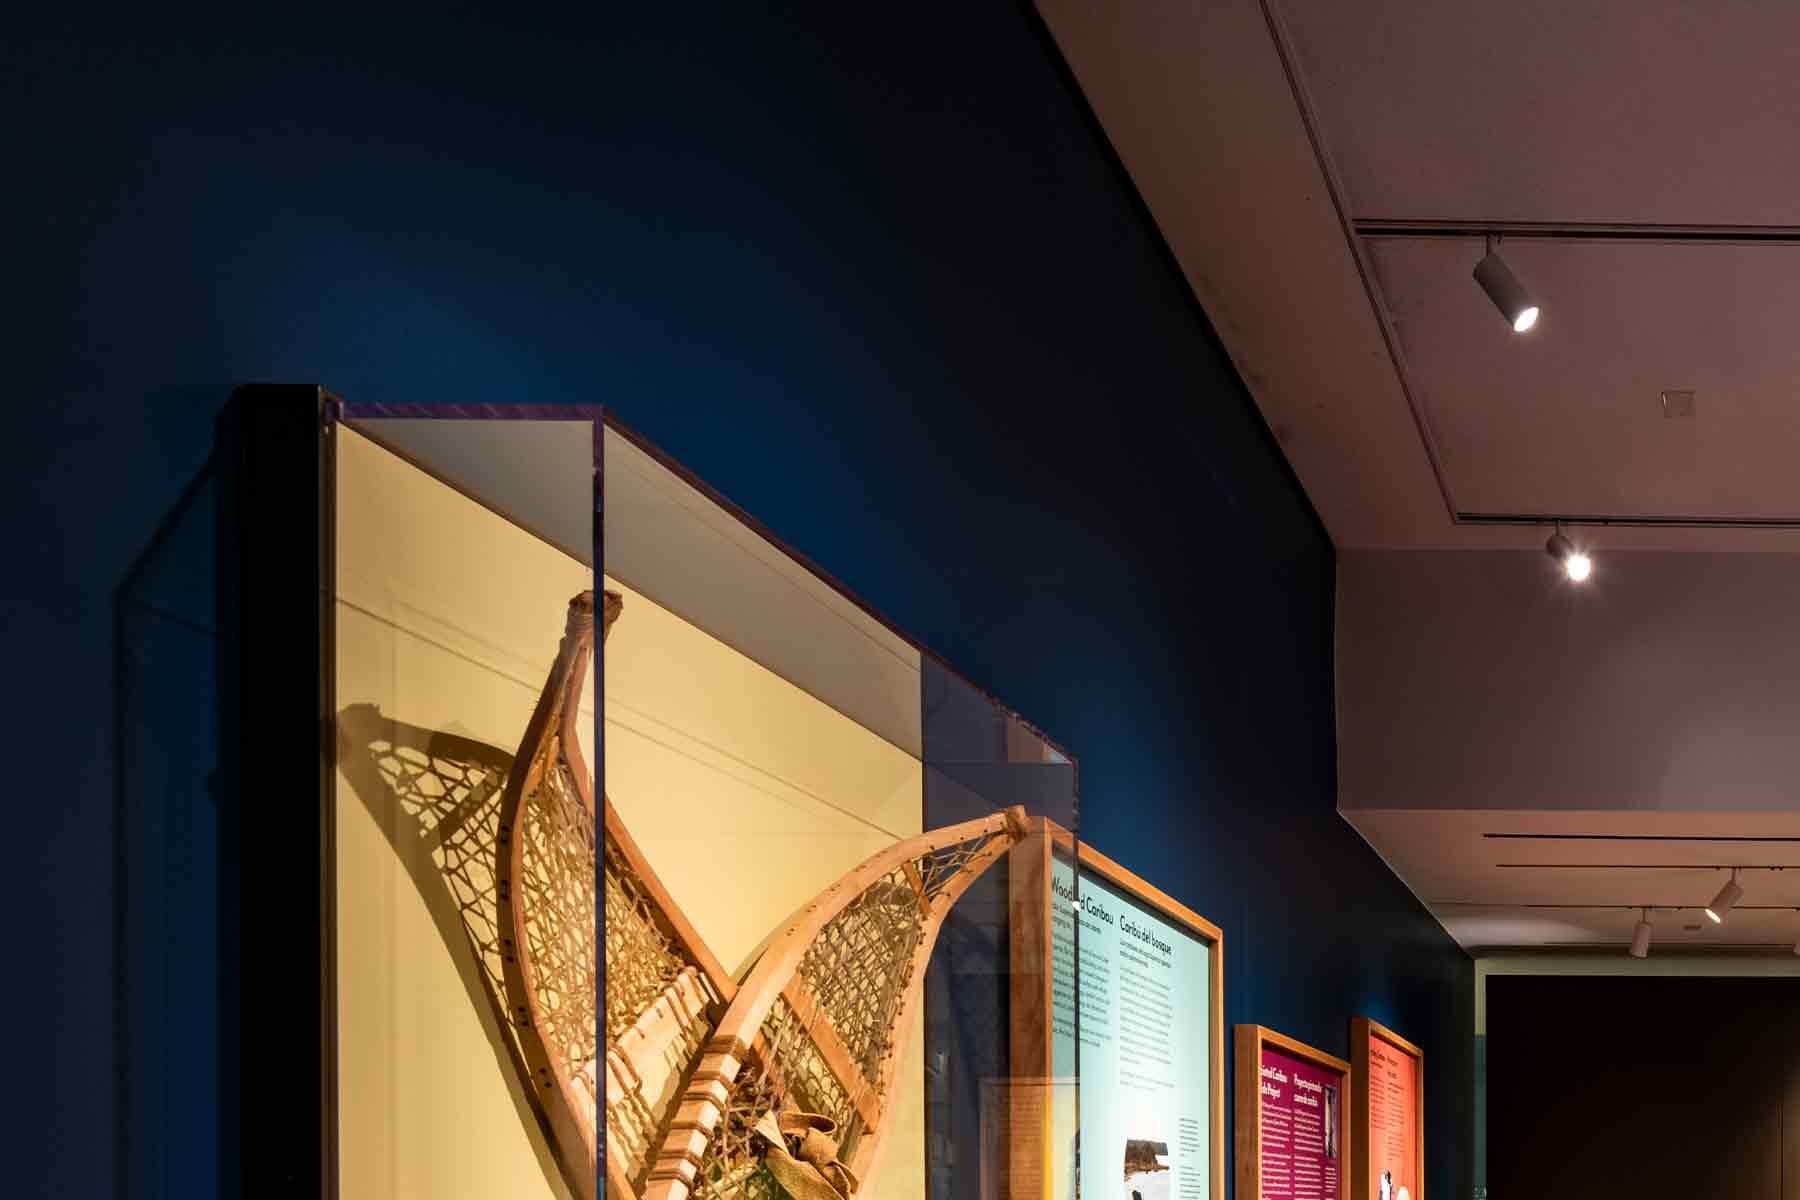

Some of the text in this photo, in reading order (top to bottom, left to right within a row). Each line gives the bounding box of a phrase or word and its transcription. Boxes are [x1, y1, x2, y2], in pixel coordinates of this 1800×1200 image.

[1052, 877, 1114, 925] Woodd Caribou
[1142, 928, 1152, 944] del
[1152, 932, 1173, 956] bosque
